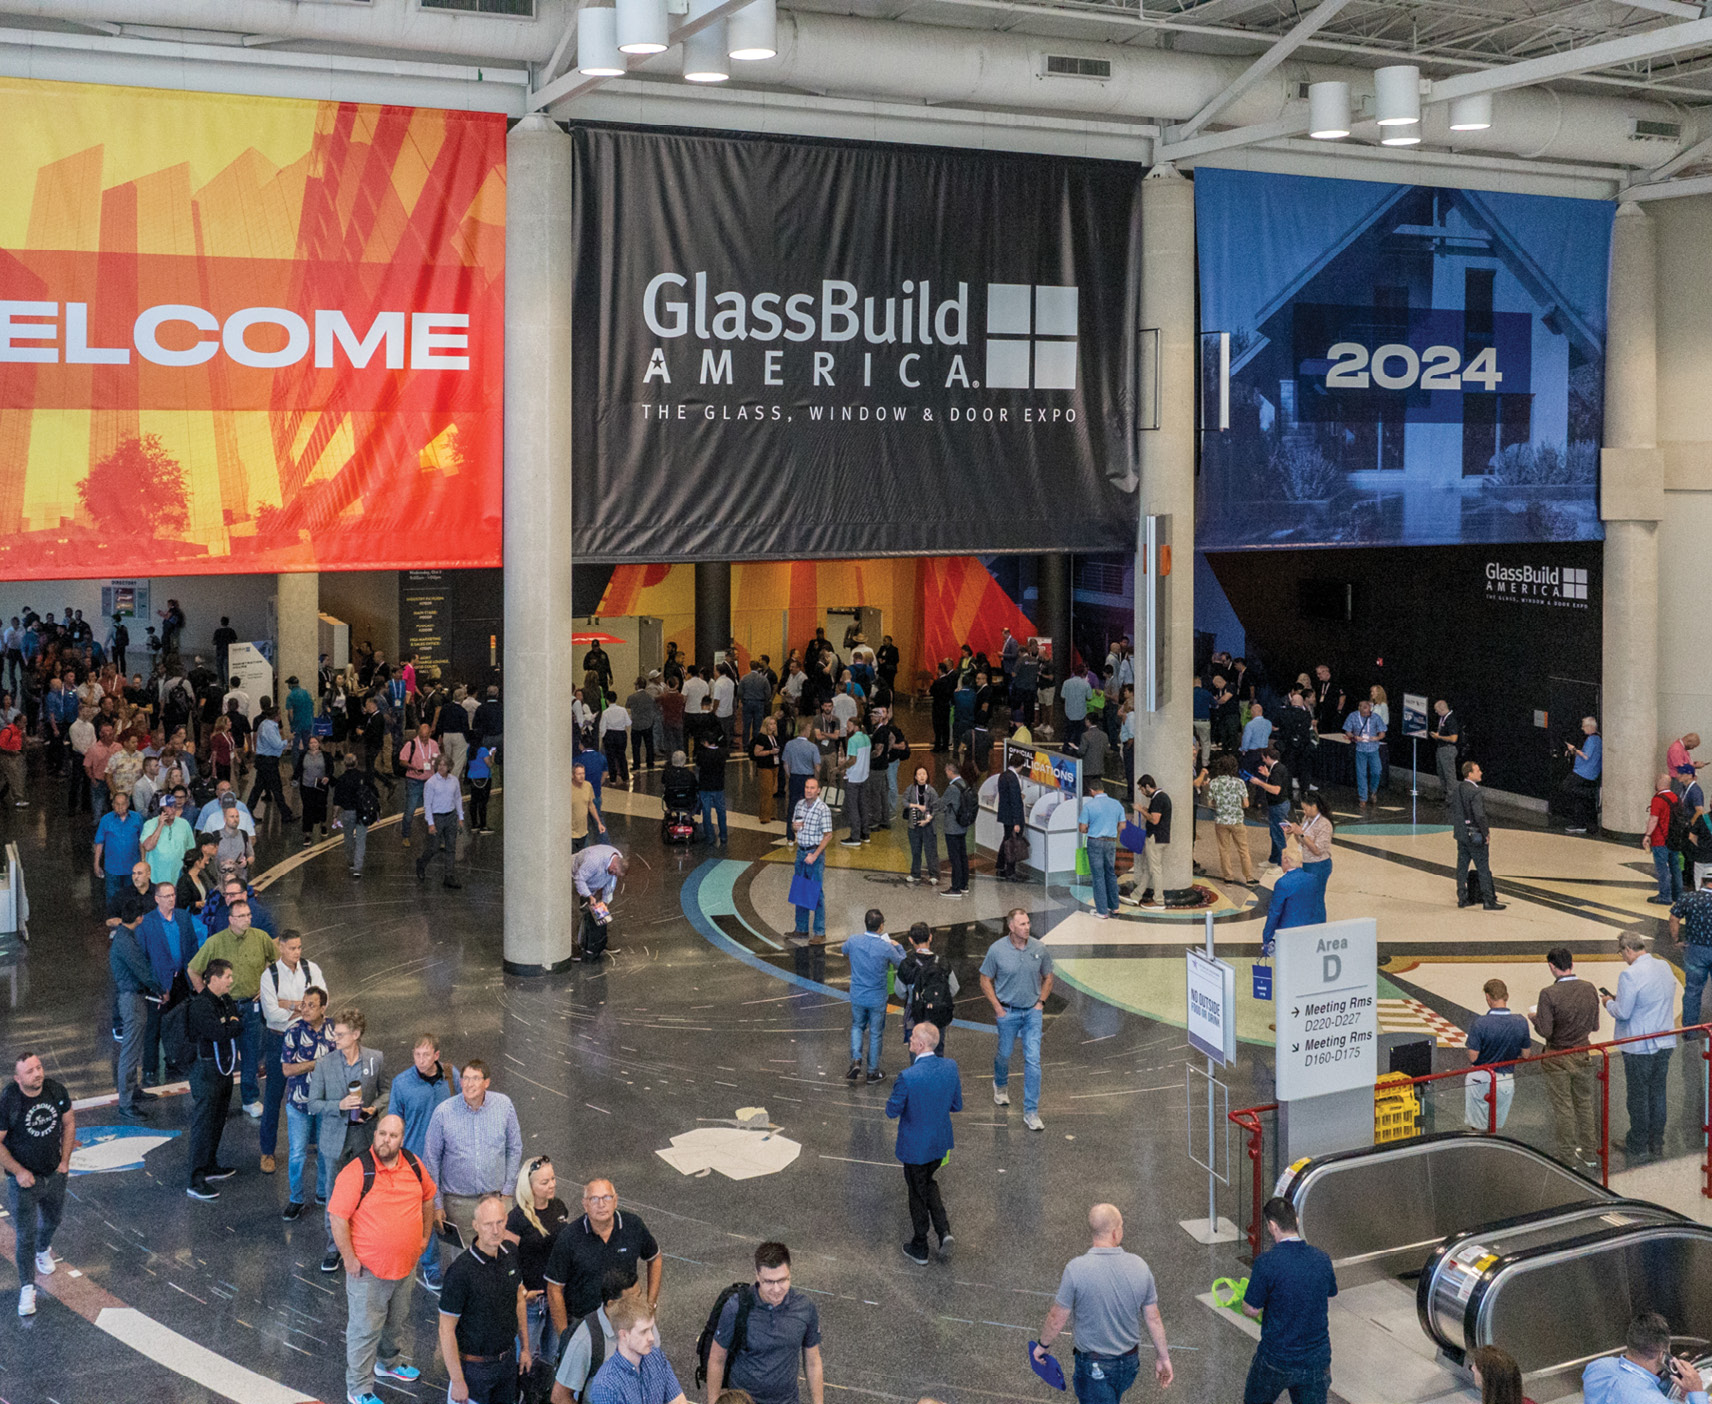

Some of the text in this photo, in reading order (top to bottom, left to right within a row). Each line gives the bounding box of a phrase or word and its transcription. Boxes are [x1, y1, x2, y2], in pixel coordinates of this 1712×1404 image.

[643, 271, 968, 345] GlassBuild
[0, 300, 469, 370] ELCOME
[1326, 342, 1503, 391] 2024
[642, 404, 1077, 423] THE GLASS, WINDOW & DOOR EXPO
[1485, 562, 1559, 585] GlassBuild
[1009, 747, 1034, 760] OFFICIAL
[1009, 753, 1074, 783] LICATIONS
[1316, 938, 1348, 953] Area
[1322, 954, 1342, 983] D
[1190, 988, 1221, 1018] NO OUTSIDE
[1304, 996, 1373, 1017] Meeting Rms
[1304, 1012, 1362, 1033] D220-D227
[1304, 1030, 1373, 1052] Meeting Rms
[1304, 1046, 1361, 1067] D160-D175
